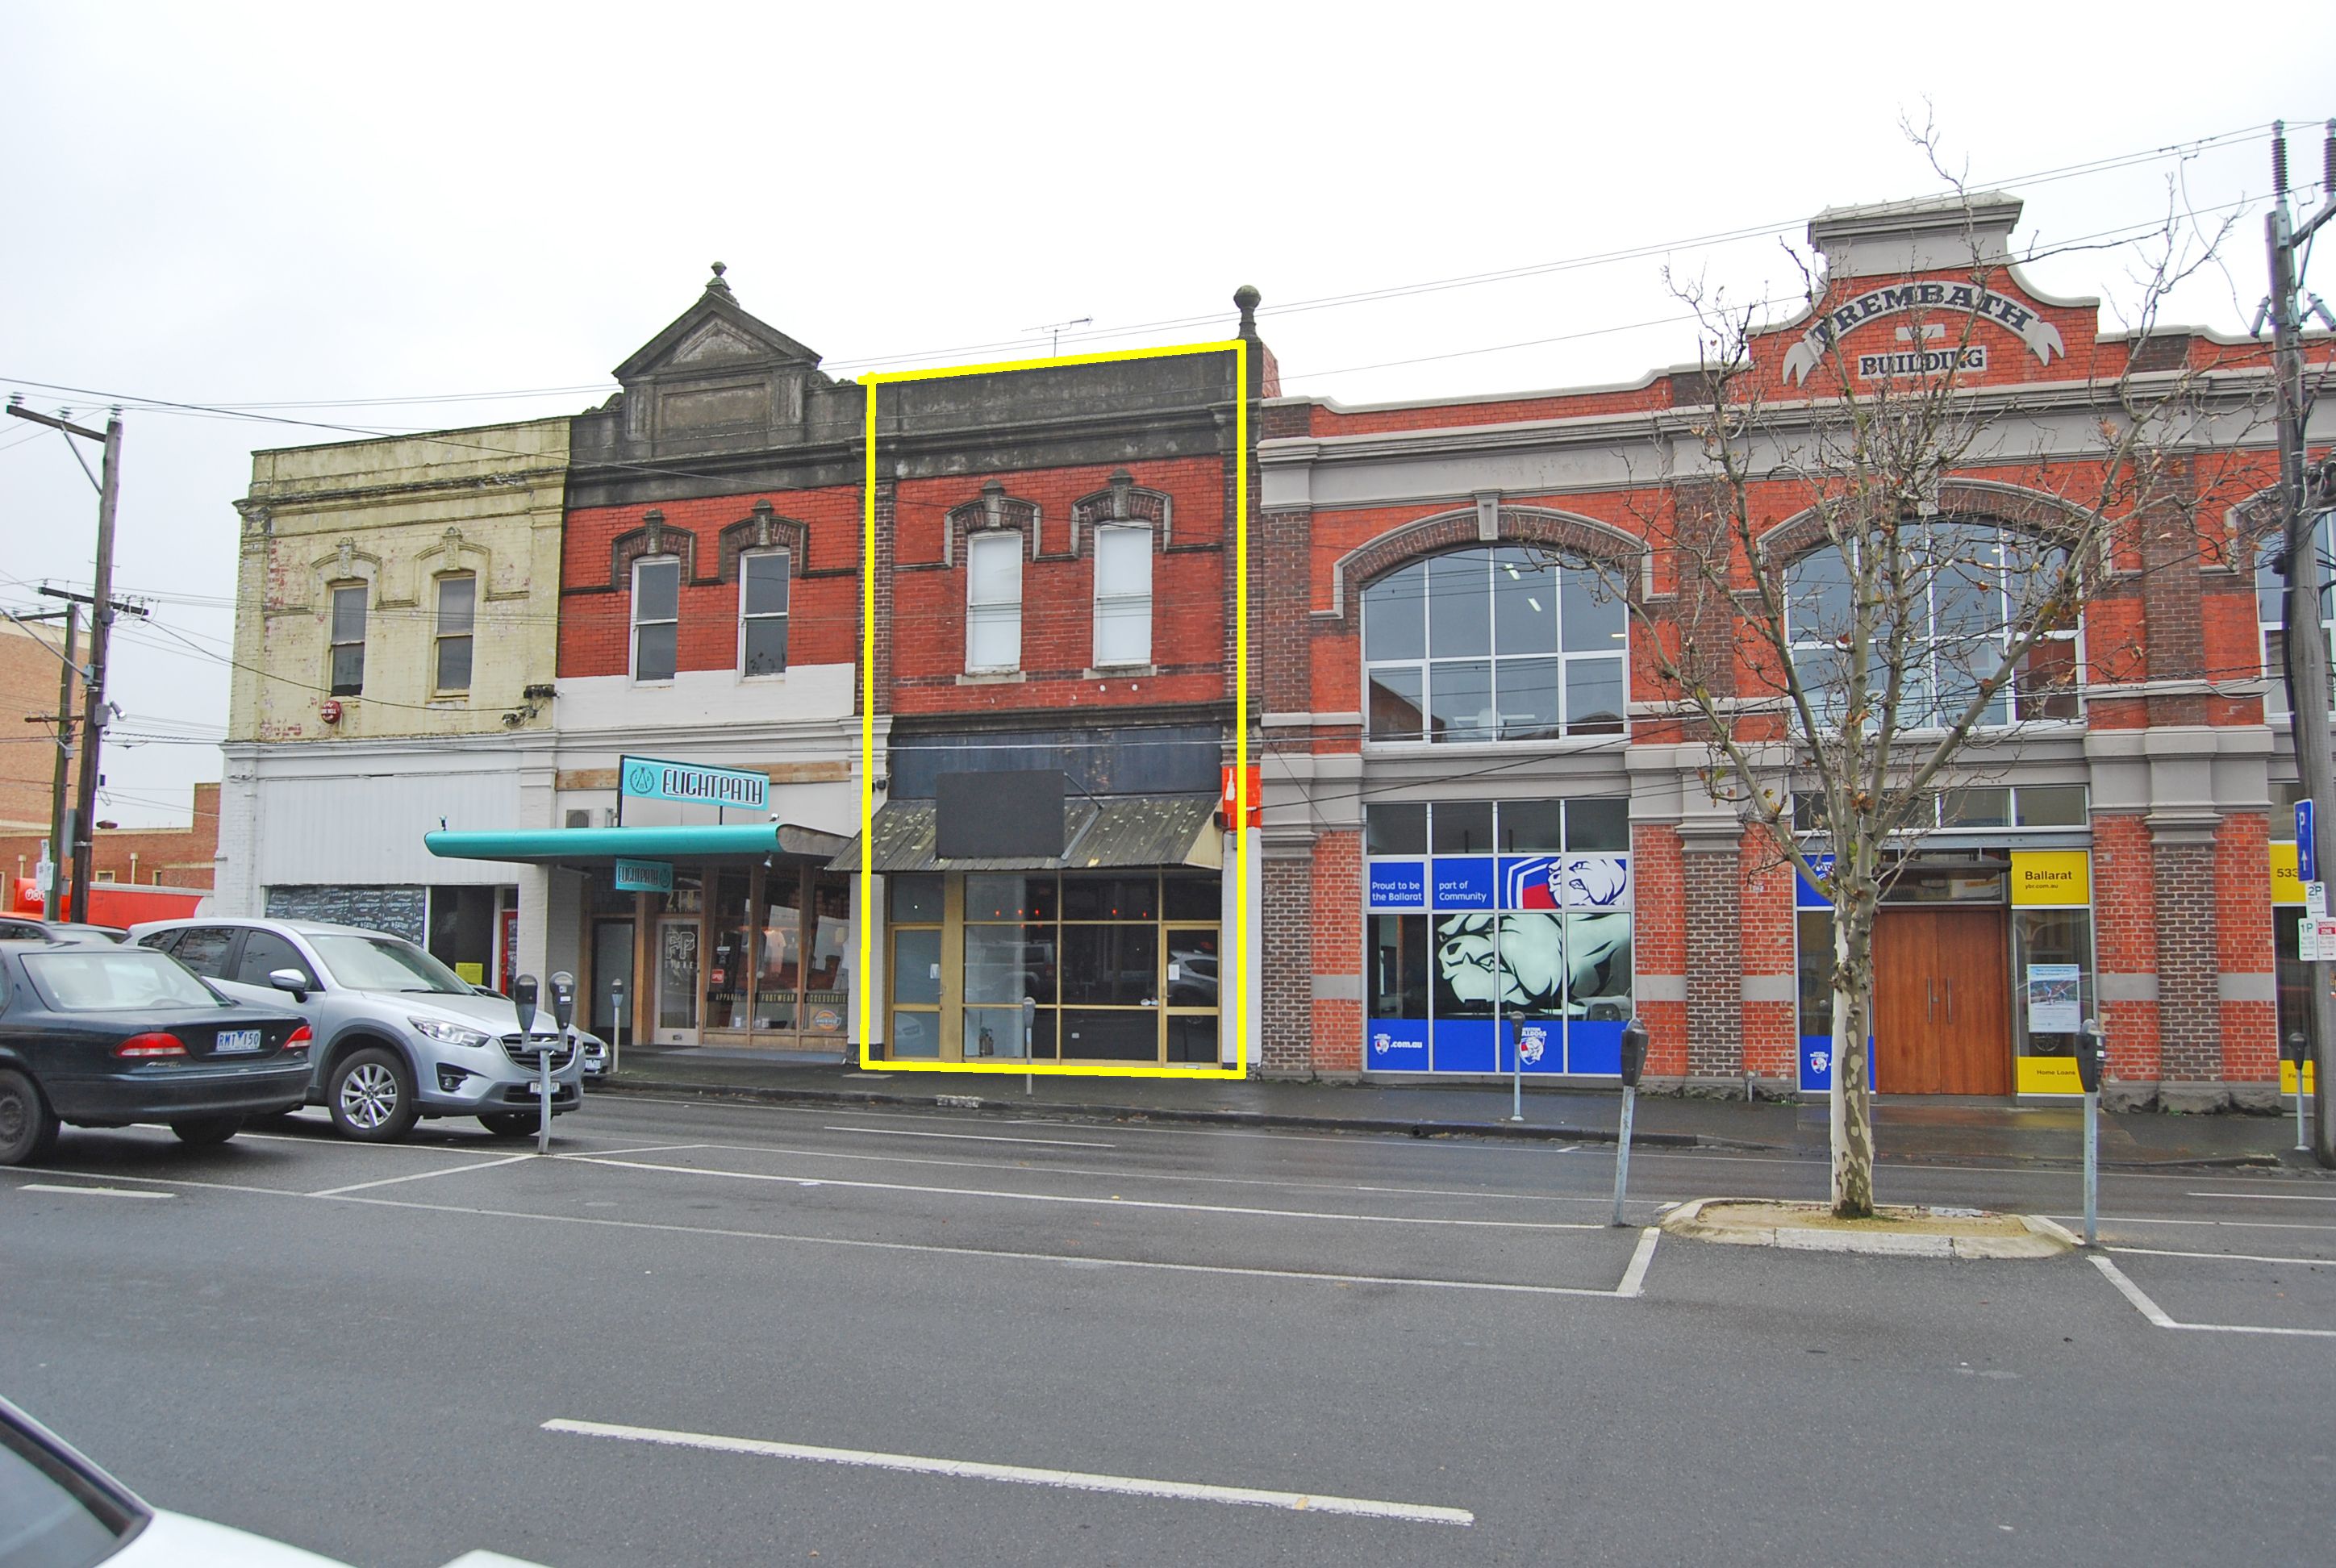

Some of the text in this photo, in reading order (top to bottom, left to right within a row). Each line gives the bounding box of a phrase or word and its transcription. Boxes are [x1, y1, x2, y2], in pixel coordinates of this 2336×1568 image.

[1812, 285, 2034, 343] TREMBATH
[662, 769, 763, 805] FLIGHTPATH
[2299, 811, 2305, 834] P
[618, 866, 659, 885] FLIGHTPATH
[2025, 870, 2072, 880] Ballarat
[1372, 881, 1468, 890] Proud to be part of
[2308, 886, 2322, 896] 2P
[1372, 892, 1487, 903] the Ballarat Community
[2301, 923, 2313, 933] 1P
[761, 993, 795, 1002] FOOTWEAR
[807, 994, 846, 1003] CCESSORIE
[219, 1033, 260, 1046] RMT 150
[1390, 1040, 1423, 1049] .com.au
